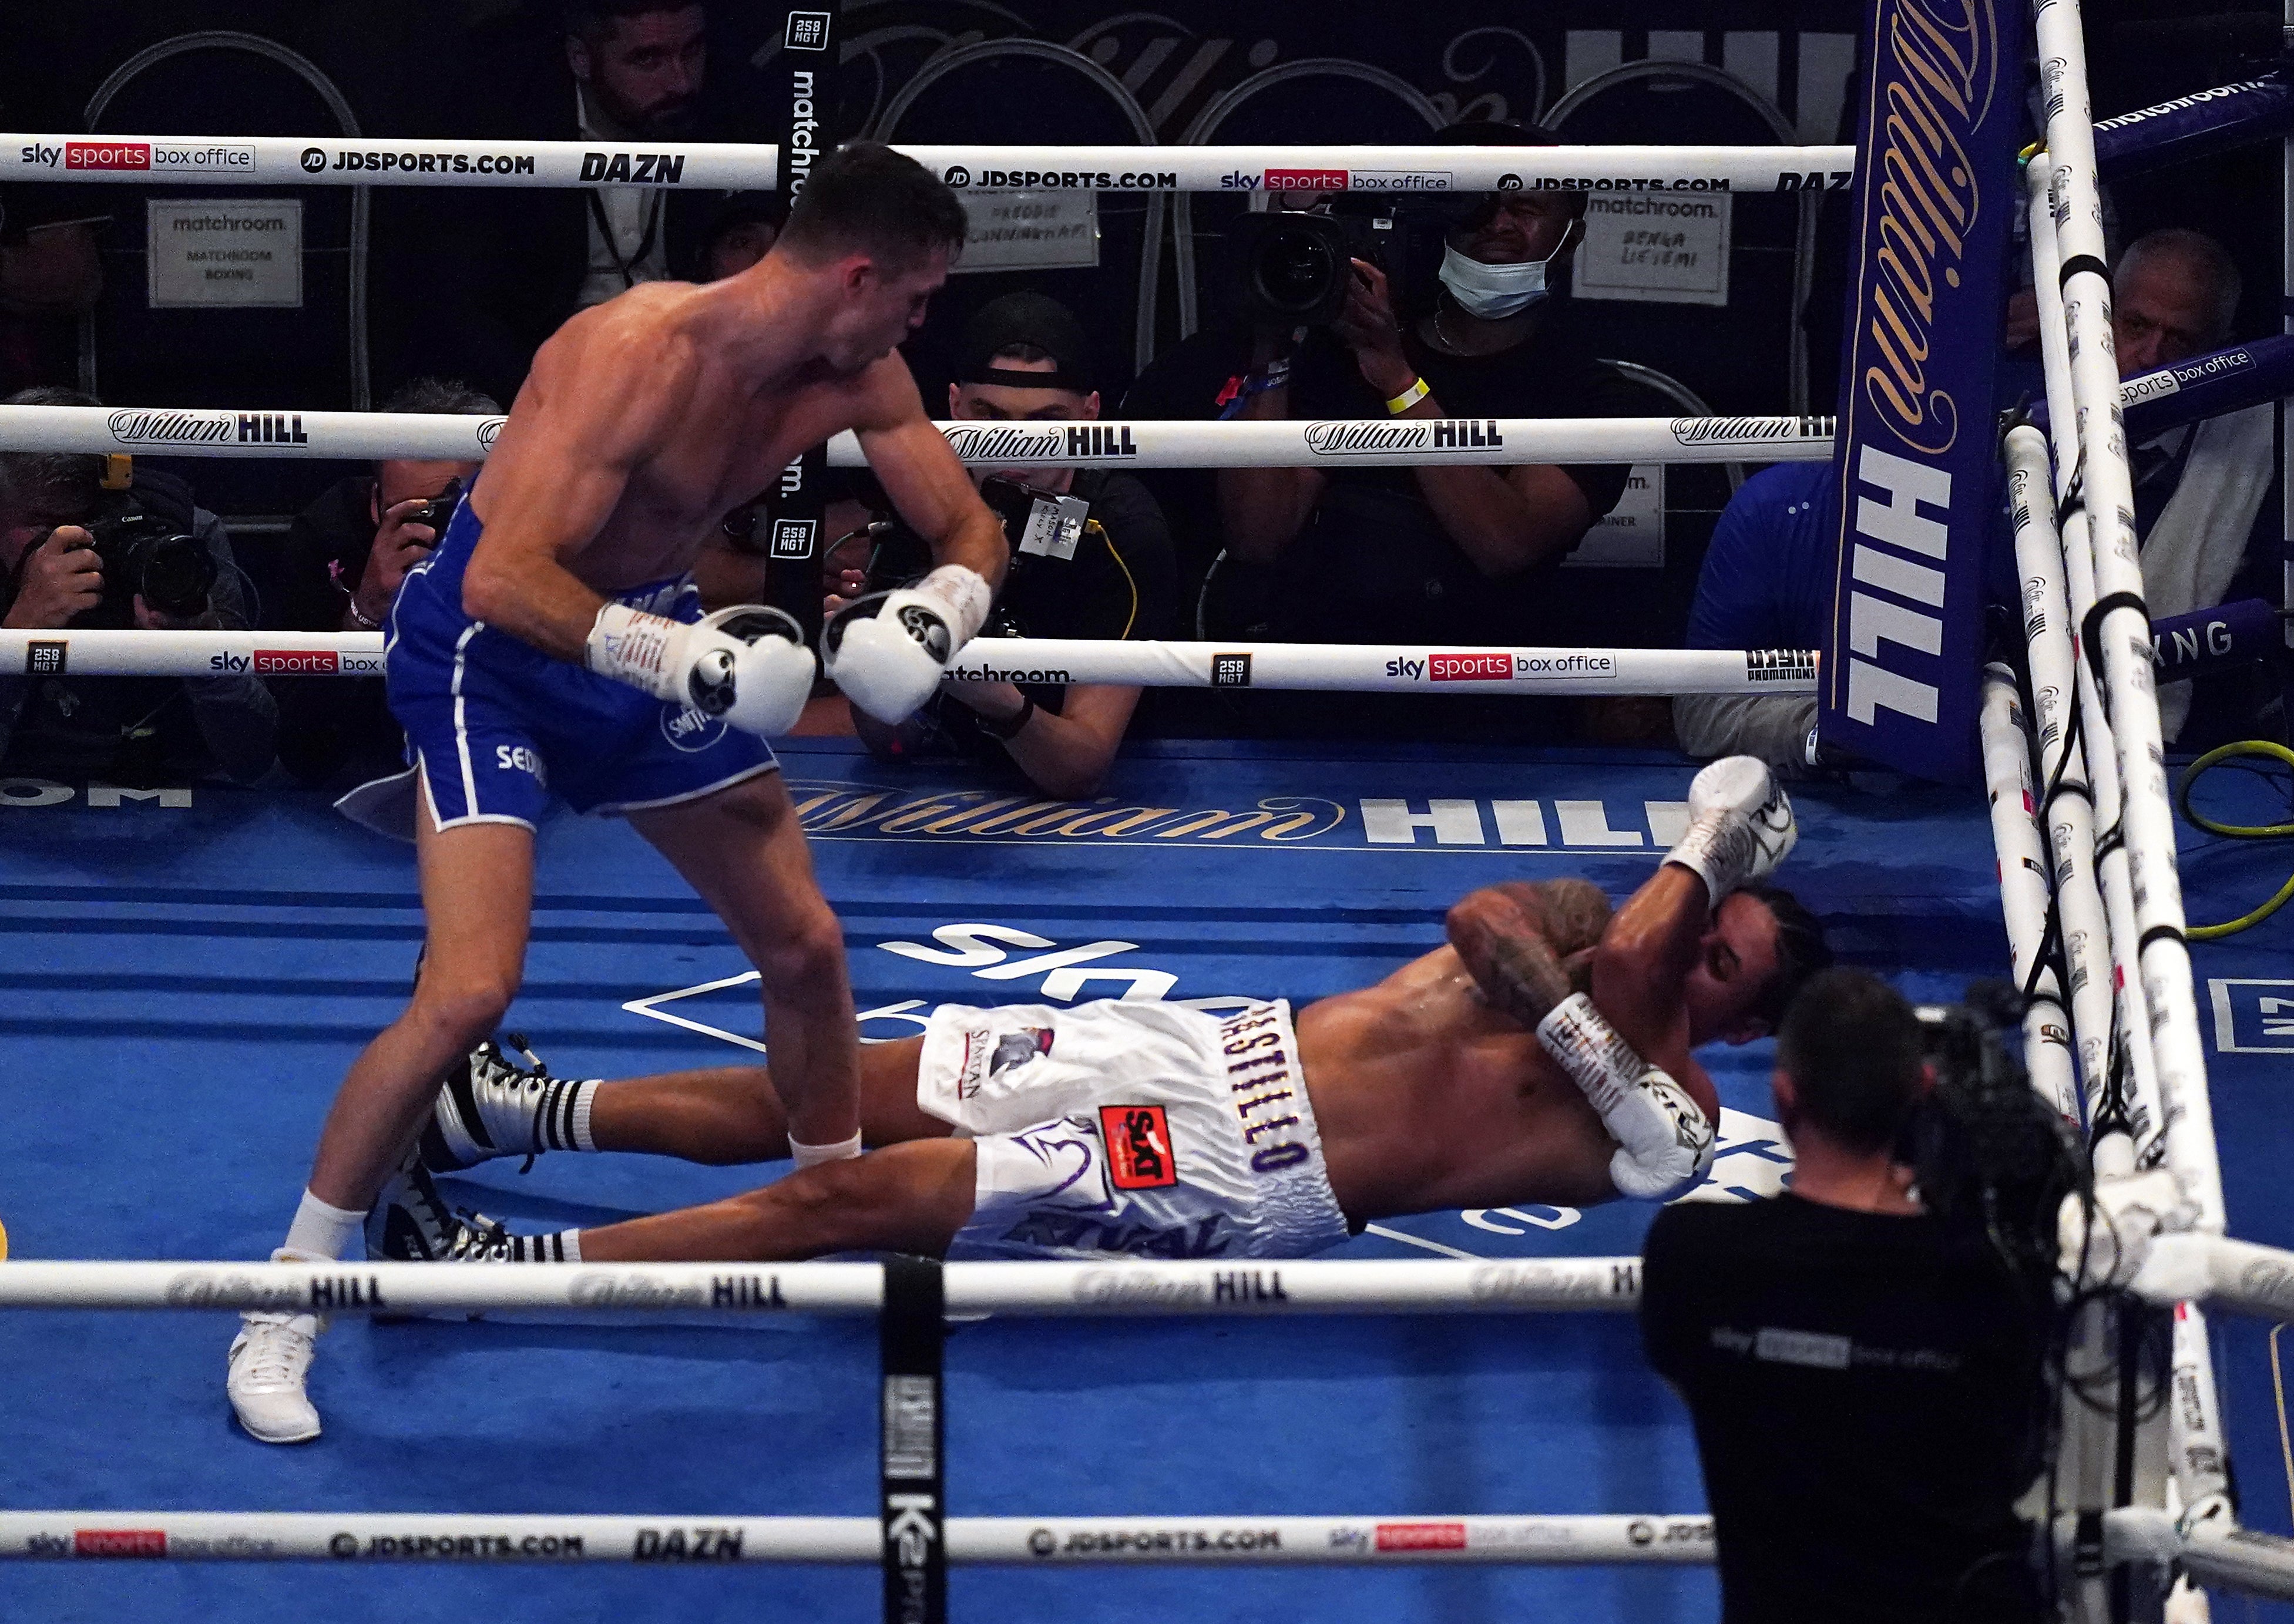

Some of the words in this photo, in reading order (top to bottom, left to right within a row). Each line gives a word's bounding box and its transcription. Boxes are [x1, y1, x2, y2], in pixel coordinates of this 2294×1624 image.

[796, 20, 822, 32] 258
[794, 32, 819, 43] MGT
[791, 71, 819, 208] matchro
[22, 143, 62, 167] sky
[69, 146, 146, 169] sports
[154, 147, 191, 165] box
[194, 147, 250, 166] office
[332, 151, 535, 175] JDSPORTS.COM
[579, 152, 686, 184] DAZN
[976, 170, 1177, 189] JDSPORTS.COM
[1221, 173, 1261, 191] sky
[1269, 173, 1344, 191] sports
[1352, 174, 1387, 190] box
[1390, 174, 1448, 190] office
[1530, 177, 1730, 191] JDSPORTS.COM
[1775, 171, 1853, 191] DAZ
[186, 250, 273, 263] MATCHROOM
[204, 268, 254, 282] BOXING
[2174, 365, 2206, 382] box
[2205, 353, 2249, 373] office
[108, 408, 236, 445] William
[238, 413, 308, 443] HILL
[1304, 421, 1432, 453] William
[1433, 421, 1503, 448] HILL
[1670, 416, 1799, 445] William
[1067, 425, 1136, 456] HILL
[781, 526, 807, 539] 258
[780, 539, 806, 551] MGT
[1846, 443, 1952, 727] HILL
[34, 648, 59, 661] 258
[210, 651, 250, 673] sky
[259, 654, 334, 673] sports
[343, 656, 378, 671] box
[33, 661, 59, 672] MGT
[942, 664, 1077, 684] atchroom.
[1218, 660, 1244, 673] 258
[1385, 655, 1426, 681] sky
[1433, 656, 1509, 678] sports
[1517, 656, 1551, 672] box
[1555, 655, 1611, 671] office
[1747, 668, 1815, 681] PROMOTIONS
[1218, 673, 1244, 685] MGT
[311, 1274, 385, 1309] HILL
[710, 1274, 787, 1309] HILL
[1213, 1270, 1287, 1300] HILL
[633, 1527, 745, 1562] DAZN
